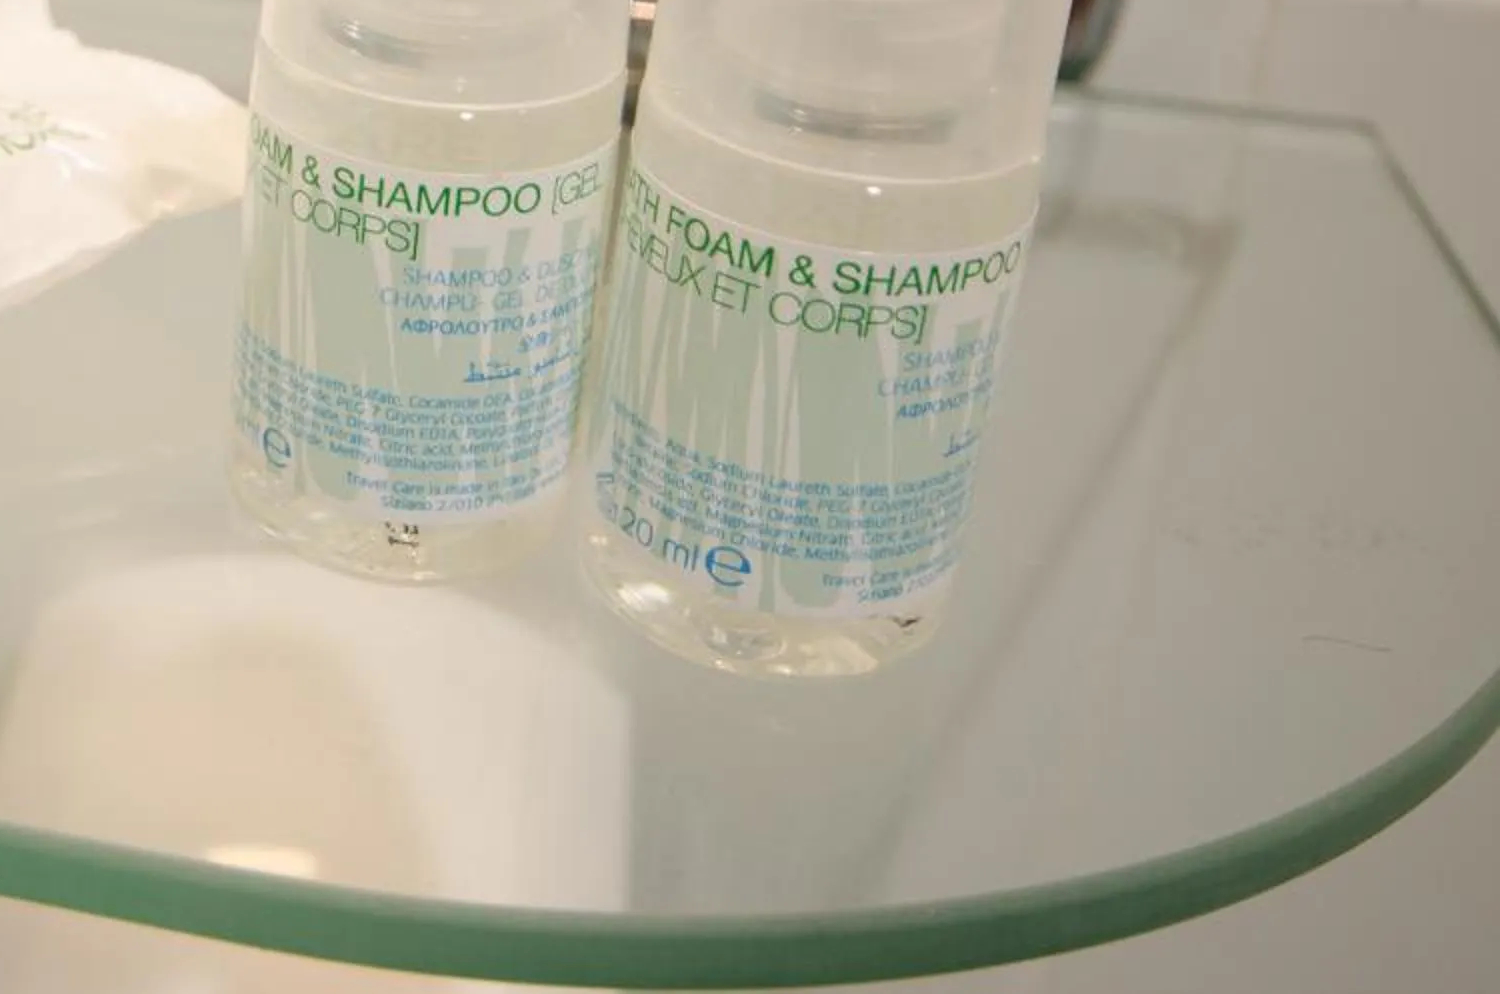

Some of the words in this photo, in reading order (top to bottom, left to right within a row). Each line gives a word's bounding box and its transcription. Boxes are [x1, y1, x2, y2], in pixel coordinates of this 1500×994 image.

[301, 154, 321, 190] &
[332, 166, 542, 218] SHAMPOO
[290, 188, 420, 261] CORPS]
[666, 204, 775, 279] FOAM
[787, 254, 817, 289] &
[832, 240, 1022, 297] SHAMPOO
[403, 266, 513, 287] SHAMPOO
[711, 270, 763, 314] ET
[768, 290, 928, 346] CORPS]
[619, 504, 653, 547] 20
[663, 537, 701, 572] ml
